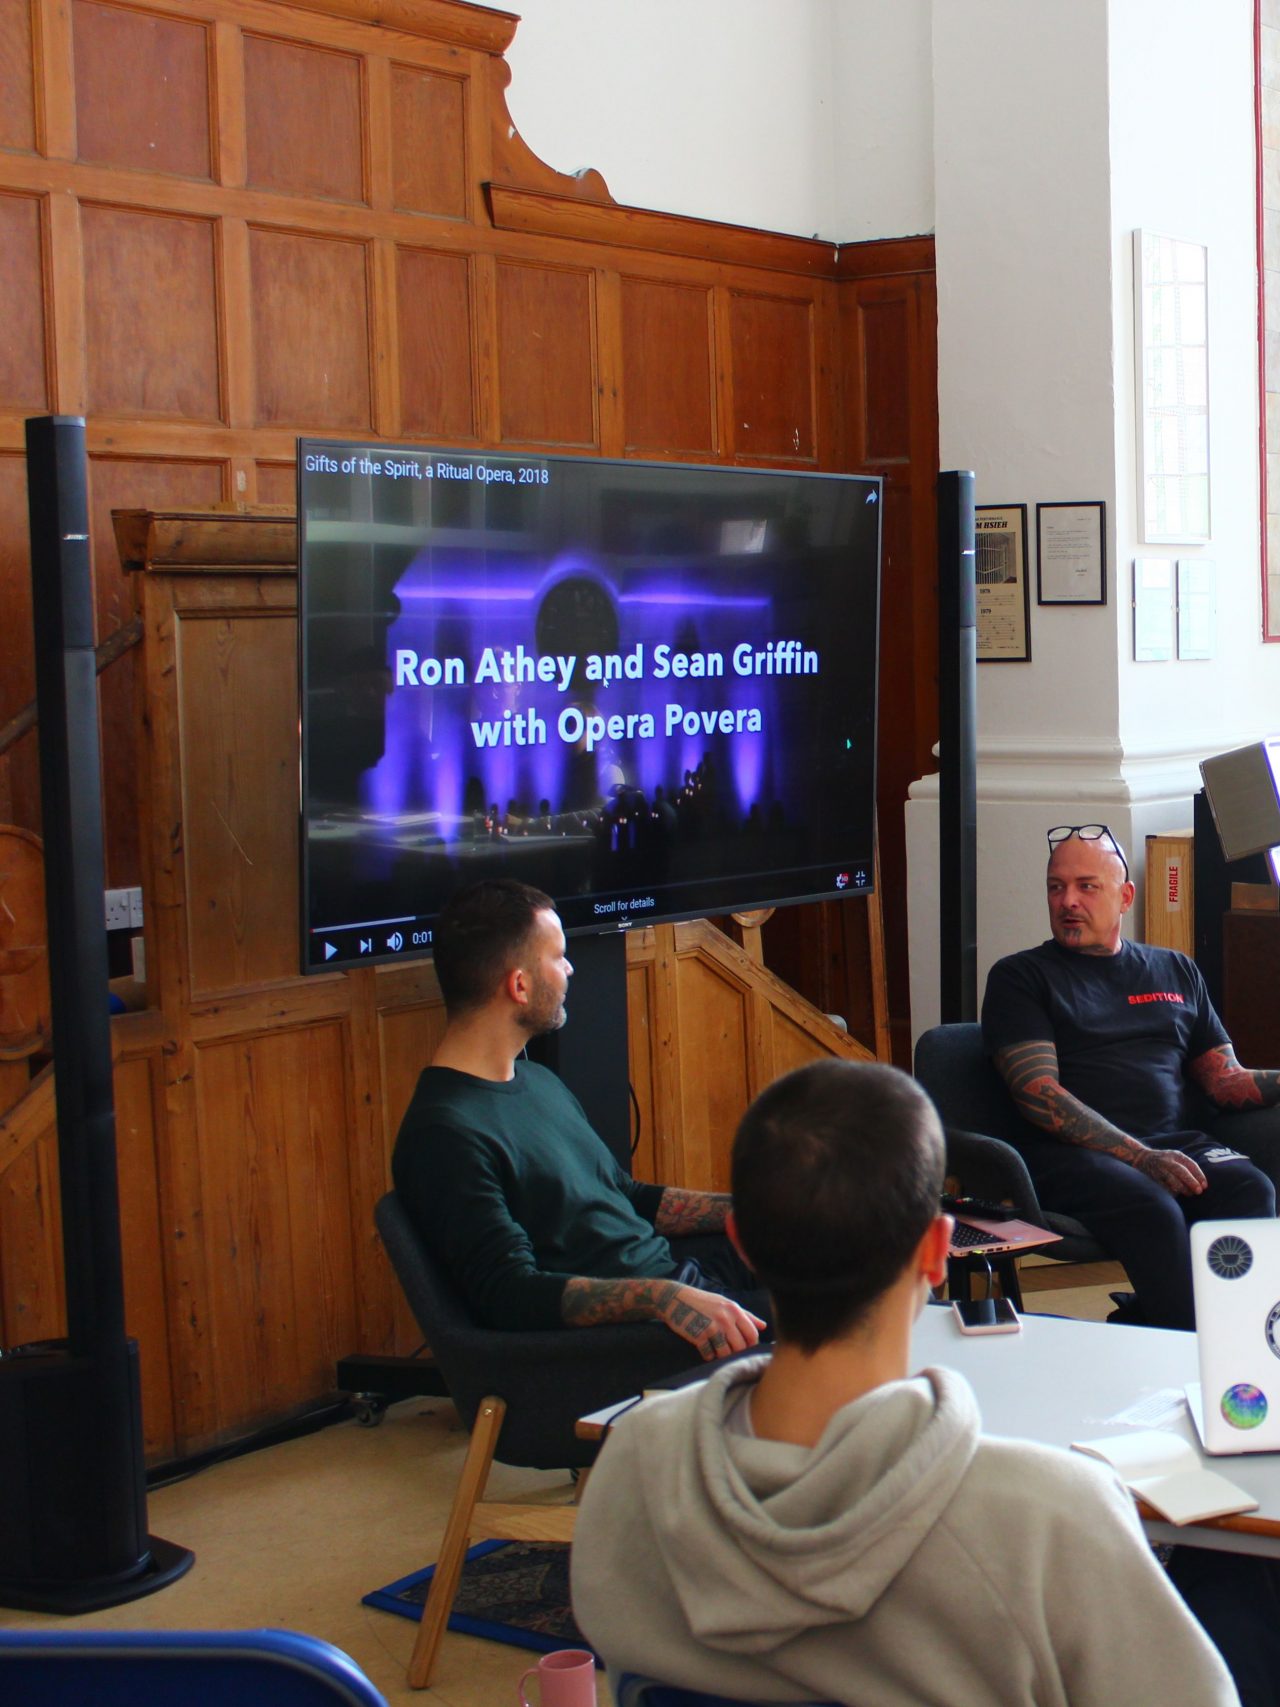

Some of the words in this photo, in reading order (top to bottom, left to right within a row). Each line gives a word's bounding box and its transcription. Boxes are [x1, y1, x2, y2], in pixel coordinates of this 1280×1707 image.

[304, 455, 338, 473] Gifts
[341, 457, 356, 474] of
[359, 457, 382, 475] the
[384, 460, 422, 480] Spirit,
[425, 465, 434, 478] a
[437, 463, 473, 480] Ritual
[476, 465, 516, 485] Opera,
[518, 468, 549, 484] 2018
[984, 521, 1008, 529] HSIEH
[396, 649, 465, 687] Ron
[474, 645, 577, 692] Athey
[585, 643, 643, 680] and
[653, 644, 723, 679] Sean
[733, 640, 819, 676] Griffin
[470, 707, 547, 748] with
[557, 707, 655, 752] Opera
[666, 704, 762, 737] Povera
[1168, 866, 1178, 903] FRAGILE
[594, 901, 616, 914] Scroll
[617, 900, 628, 911] for
[630, 896, 655, 909] details
[412, 930, 433, 945] 0:01
[1128, 992, 1185, 1005] SEDITION
